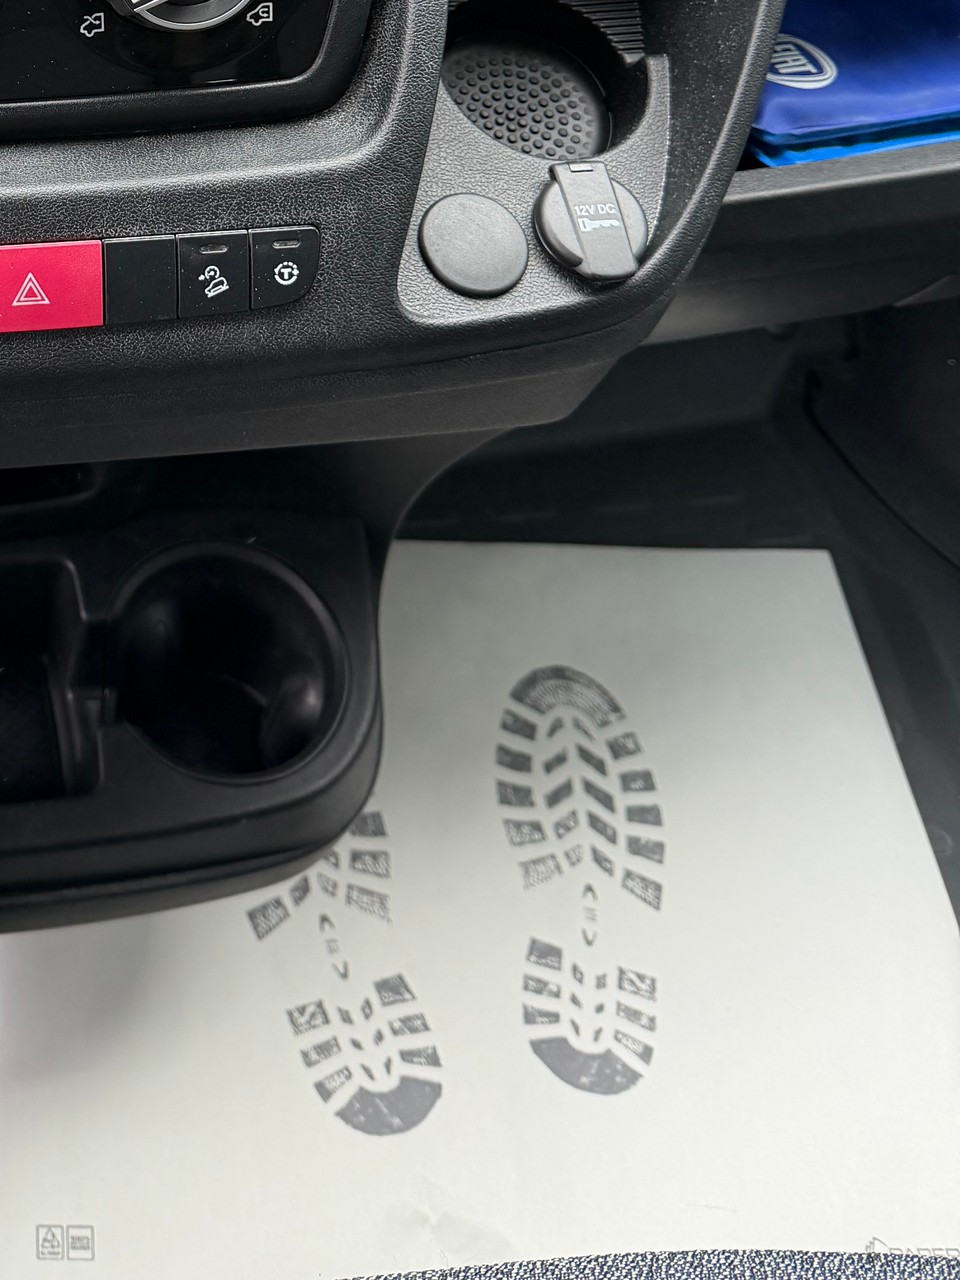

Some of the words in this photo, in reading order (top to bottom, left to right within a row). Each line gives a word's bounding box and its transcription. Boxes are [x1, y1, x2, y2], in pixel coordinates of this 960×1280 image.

[770, 43, 818, 74] FIAT
[573, 204, 596, 216] 12V
[596, 203, 617, 215] DC
